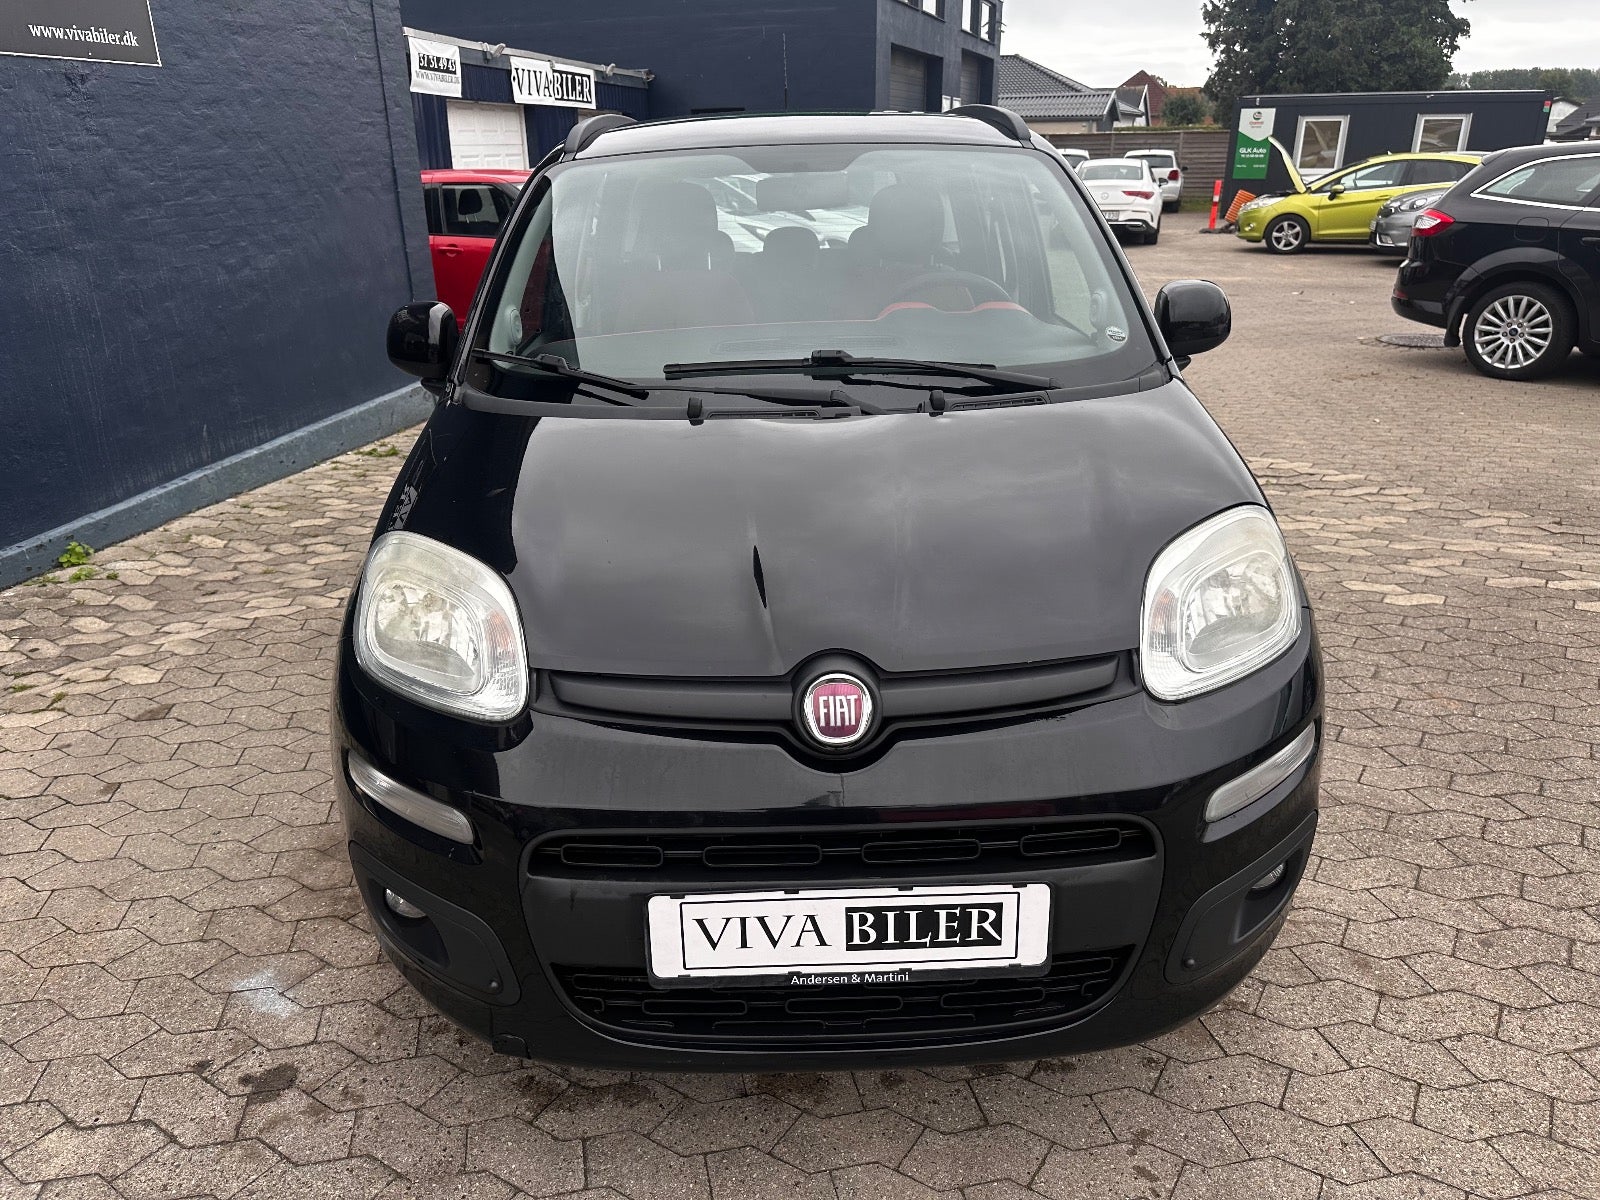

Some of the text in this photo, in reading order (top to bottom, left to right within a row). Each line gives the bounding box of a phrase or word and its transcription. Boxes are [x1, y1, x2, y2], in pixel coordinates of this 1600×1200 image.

[28, 24, 139, 47] www.vivabiler.dk
[514, 67, 592, 102] VIVA BILER
[818, 694, 859, 727] FIAT
[692, 906, 1003, 952] VIVA BILER
[790, 971, 909, 985] Andersen & Martini
